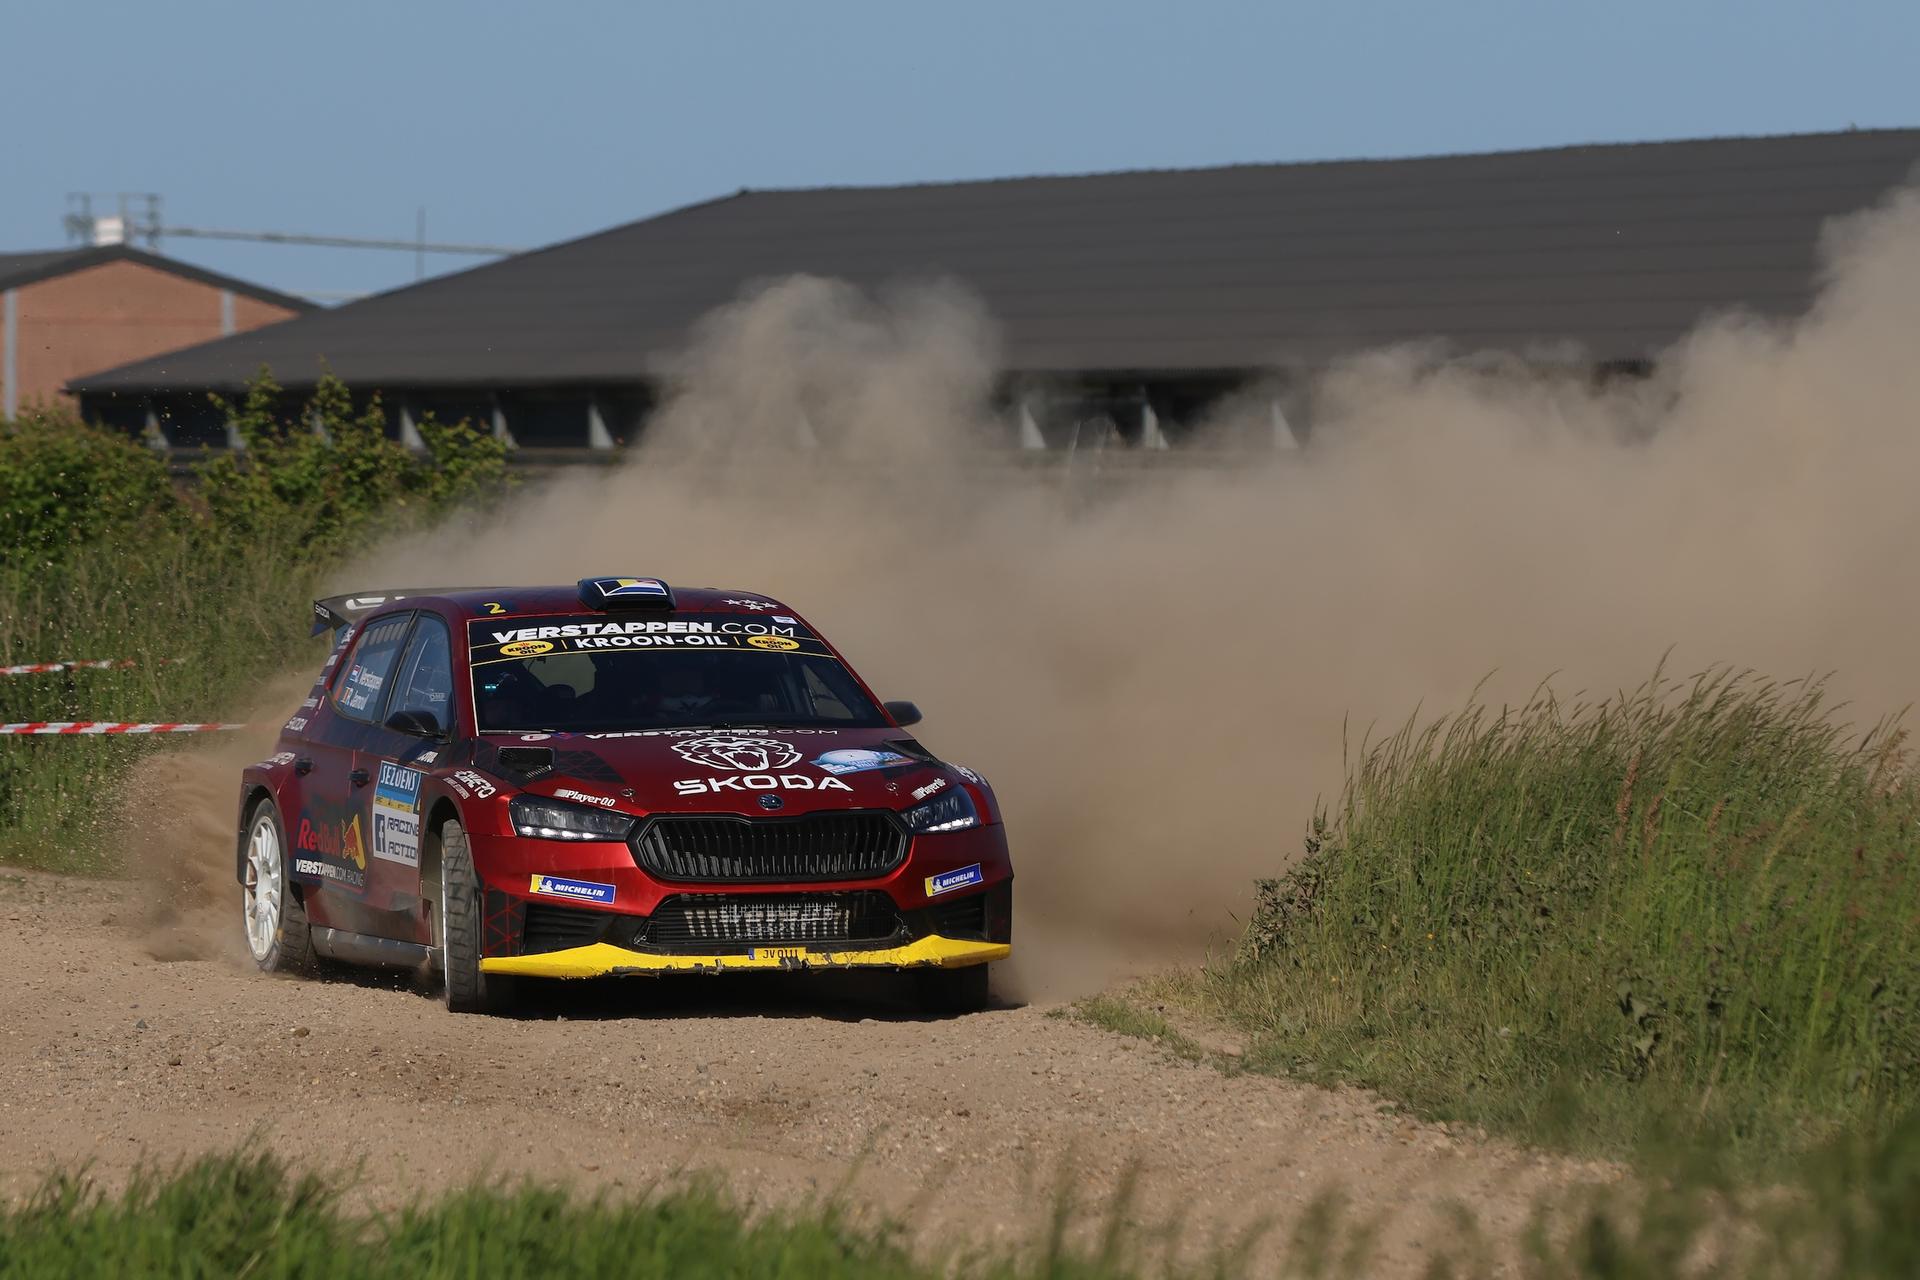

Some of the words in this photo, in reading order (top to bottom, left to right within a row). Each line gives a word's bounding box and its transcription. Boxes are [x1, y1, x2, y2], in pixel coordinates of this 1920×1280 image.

[484, 602, 506, 614] 2
[492, 621, 794, 643] VERSTAPPEN.COM
[575, 635, 728, 648] KROON-OIL
[380, 765, 417, 791] SEZOENS
[673, 774, 854, 795] SKODA
[388, 841, 418, 859] ACTIO
[942, 871, 975, 887] MICHELIN
[554, 883, 606, 897] MICHELIN
